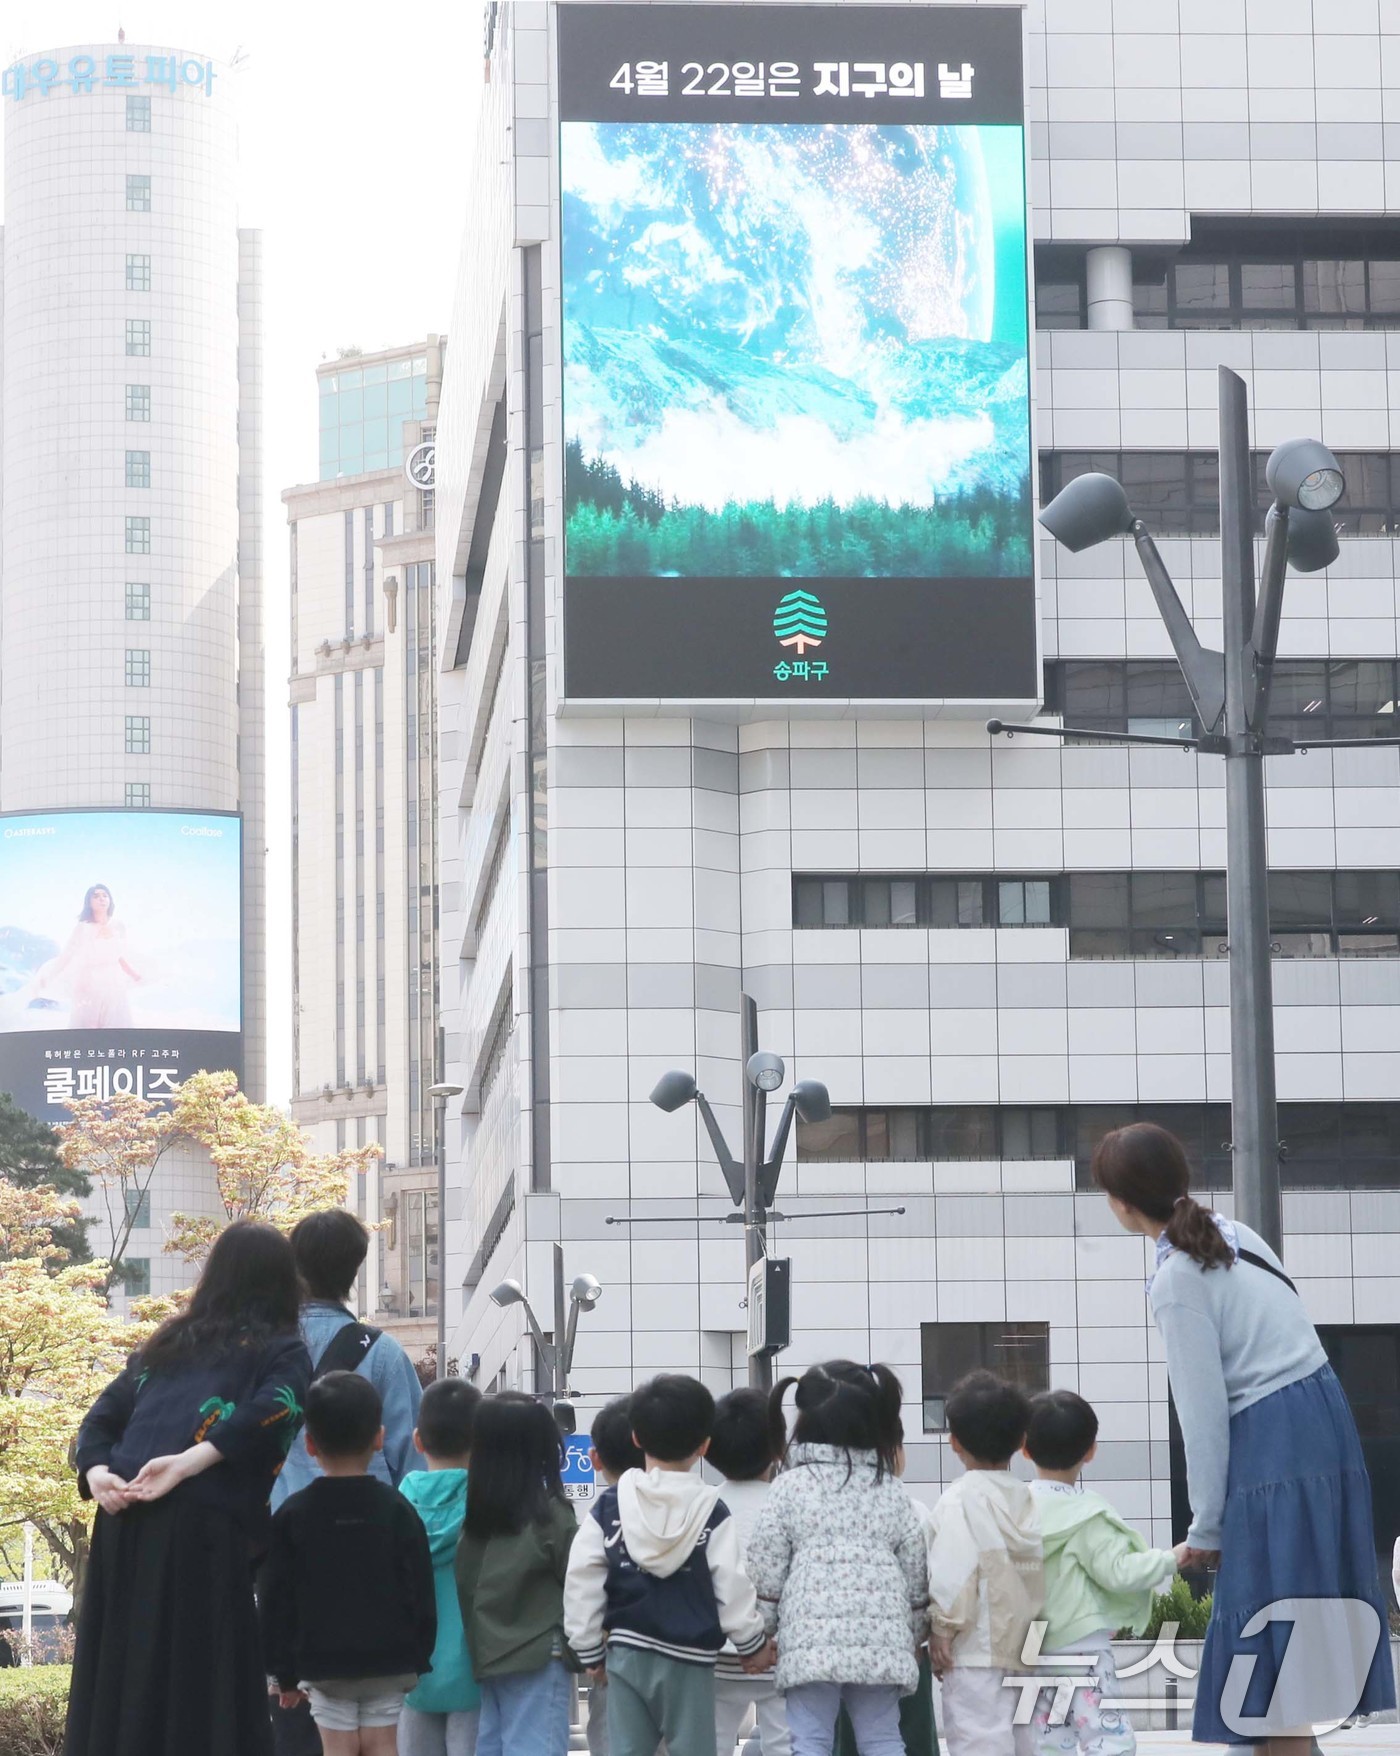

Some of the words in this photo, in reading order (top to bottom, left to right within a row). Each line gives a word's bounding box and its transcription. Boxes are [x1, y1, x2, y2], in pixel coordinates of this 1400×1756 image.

[609, 60, 669, 96] 4월
[681, 61, 802, 97] 22일은
[813, 61, 925, 98] 지구의
[937, 63, 975, 98] 날
[773, 660, 830, 681] 송파구
[45, 1050, 82, 1059] 특허받은
[151, 1050, 180, 1059] 고주파
[43, 1065, 179, 1104] 쿨페이즈
